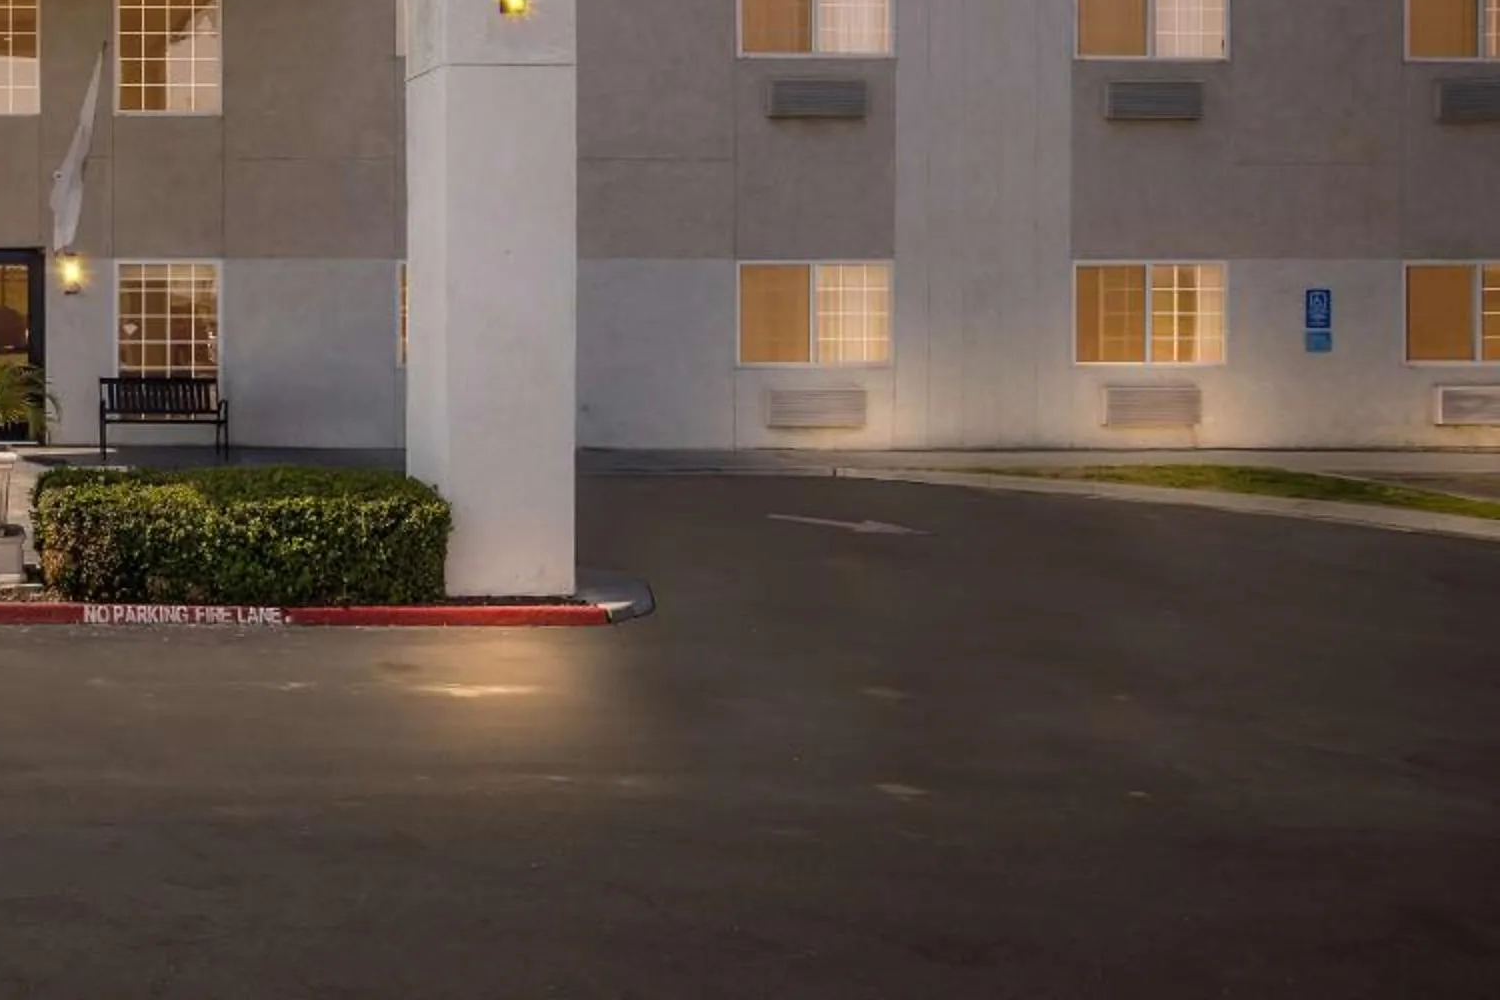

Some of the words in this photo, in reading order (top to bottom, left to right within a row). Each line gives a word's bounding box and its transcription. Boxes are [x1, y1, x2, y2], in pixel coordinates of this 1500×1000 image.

[84, 605, 109, 623] NO
[113, 605, 188, 623] PARKING
[194, 606, 232, 623] FIRE
